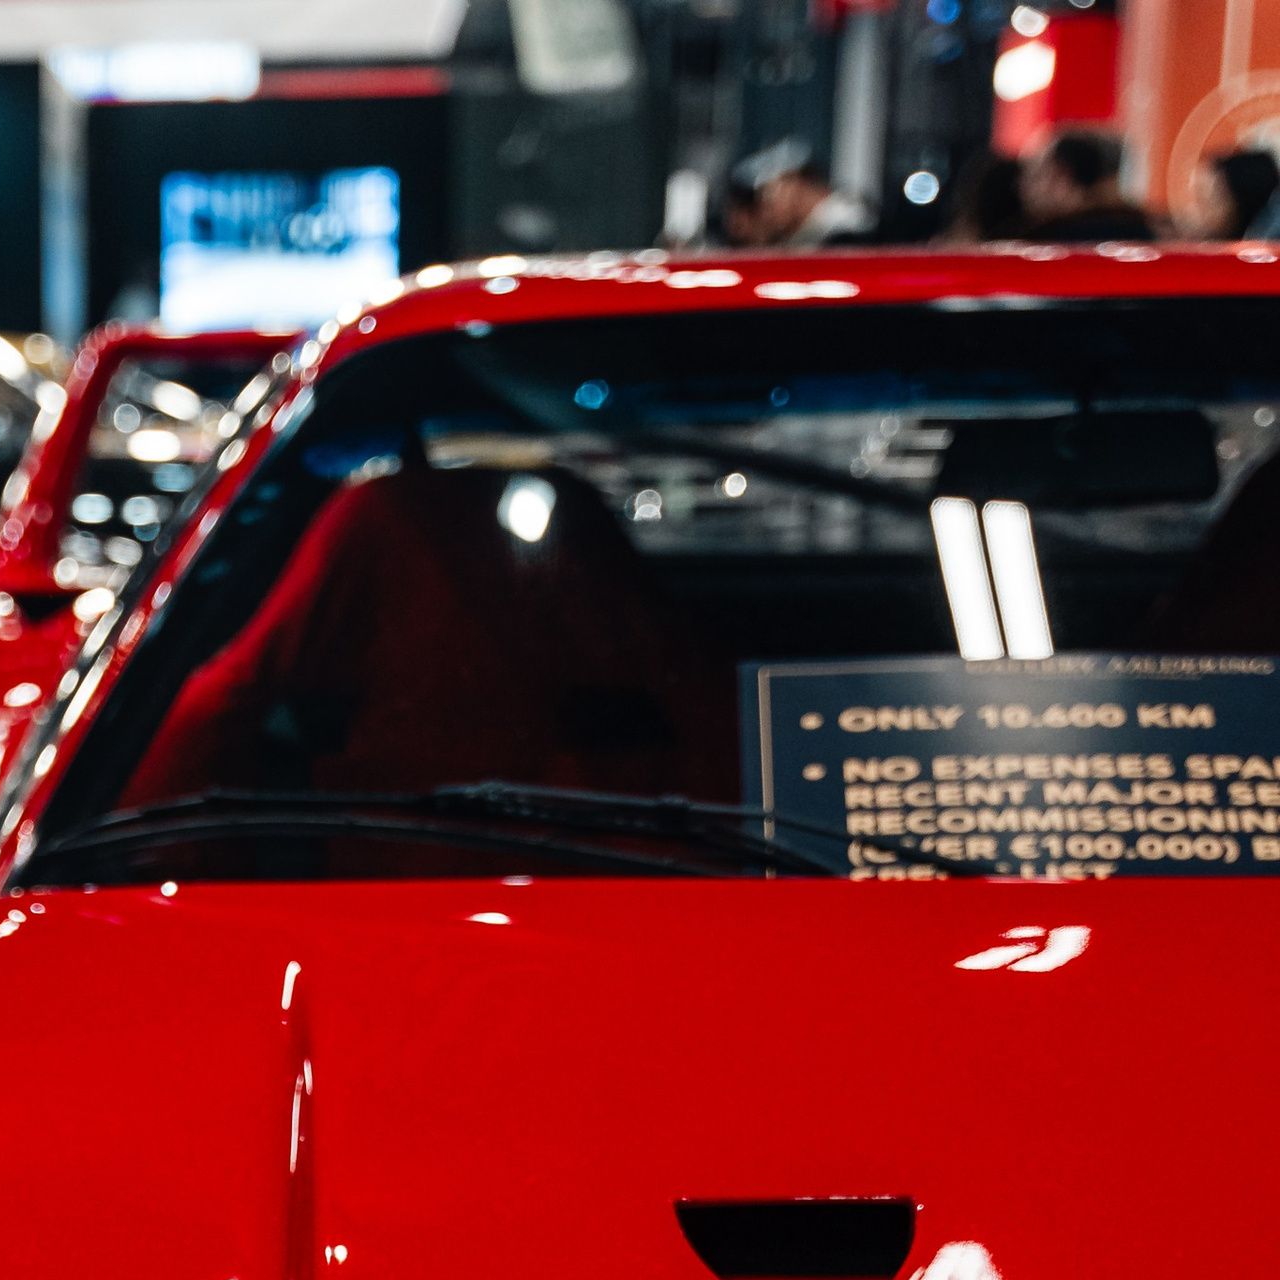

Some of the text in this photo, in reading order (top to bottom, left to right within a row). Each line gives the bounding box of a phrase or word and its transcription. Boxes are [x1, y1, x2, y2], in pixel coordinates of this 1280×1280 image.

[838, 702, 1217, 733] ONLY 10.600 KM
[842, 753, 1280, 784] NO EXPENSES SPA
[844, 780, 1029, 809] RECENT
[1042, 779, 1217, 807] MAJOR
[846, 806, 1280, 836] RECOMMISSIONIN
